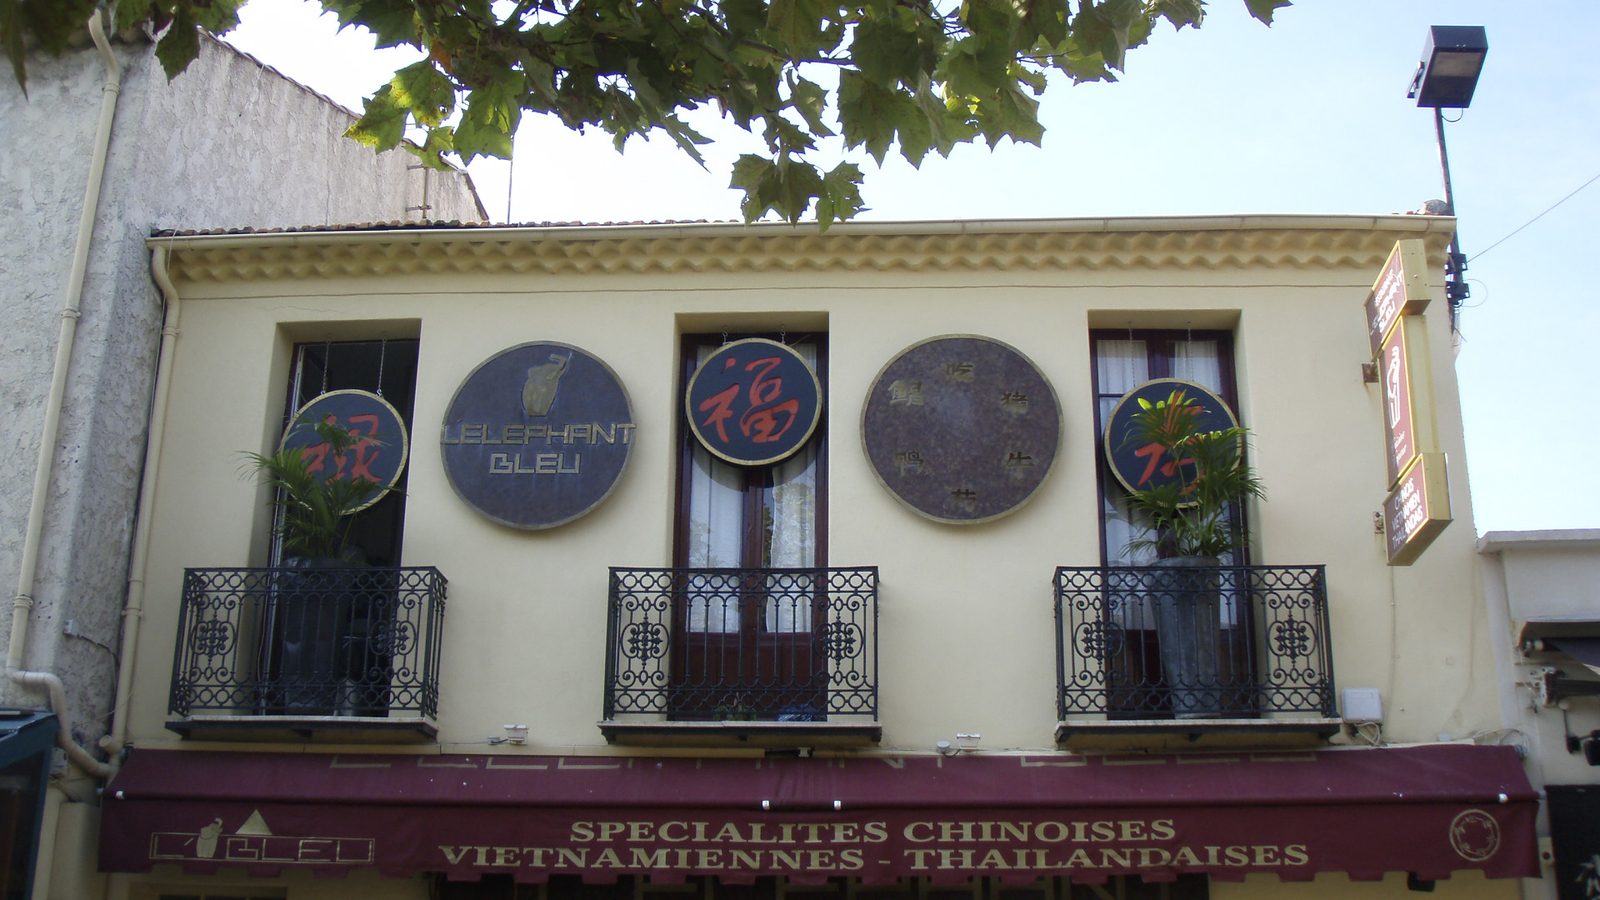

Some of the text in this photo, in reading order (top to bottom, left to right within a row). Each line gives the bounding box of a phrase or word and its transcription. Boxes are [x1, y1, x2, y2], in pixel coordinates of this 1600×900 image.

[489, 453, 581, 474] BLEU
[570, 819, 1176, 844] SPECIALITES CHINOISES
[438, 845, 865, 870] VIETNAMIENNES
[903, 845, 1310, 870] THAILANDAISES
